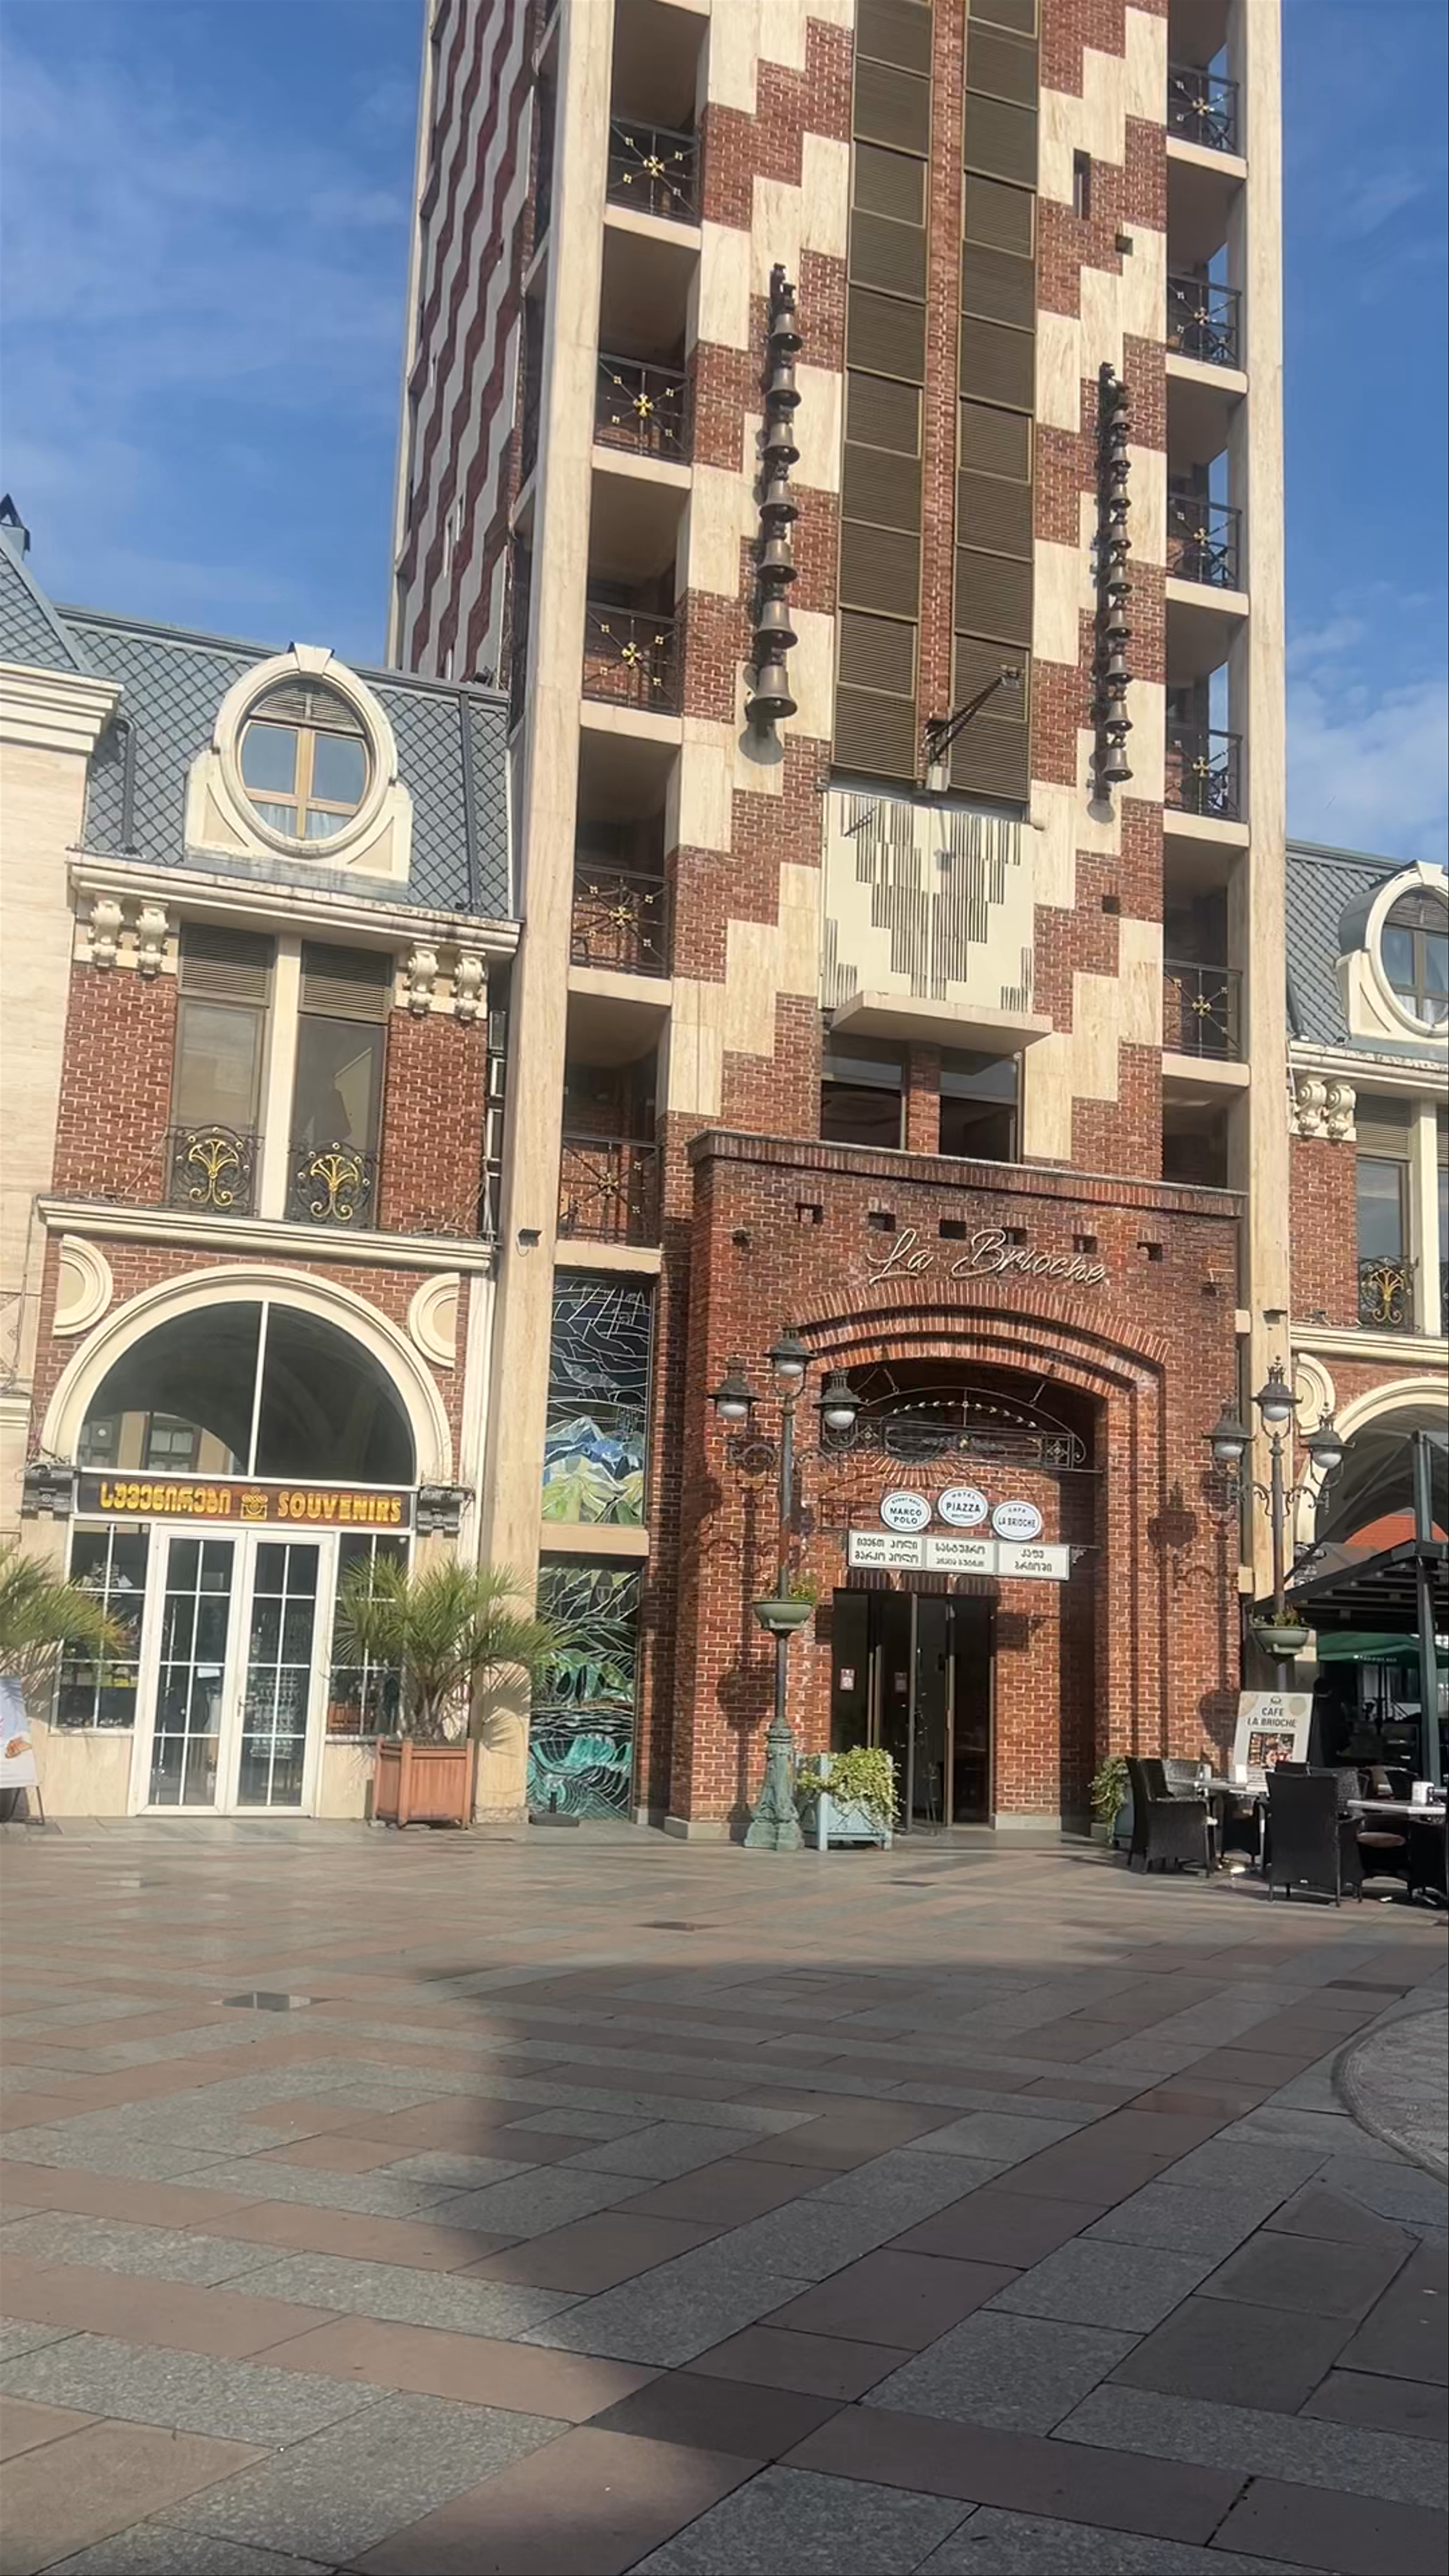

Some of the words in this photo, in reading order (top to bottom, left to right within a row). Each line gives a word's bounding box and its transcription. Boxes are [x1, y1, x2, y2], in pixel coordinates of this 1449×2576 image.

[867, 1228, 934, 1285] La
[950, 1229, 1106, 1284] Brioche
[278, 1491, 401, 1523] SOUVENIRS
[890, 1507, 922, 1516] MARCO
[946, 1502, 980, 1512] PIAZZA
[1261, 1707, 1284, 1716] CAFE
[1247, 1718, 1258, 1726] LA
[1261, 1718, 1297, 1728] BRIOCHE
